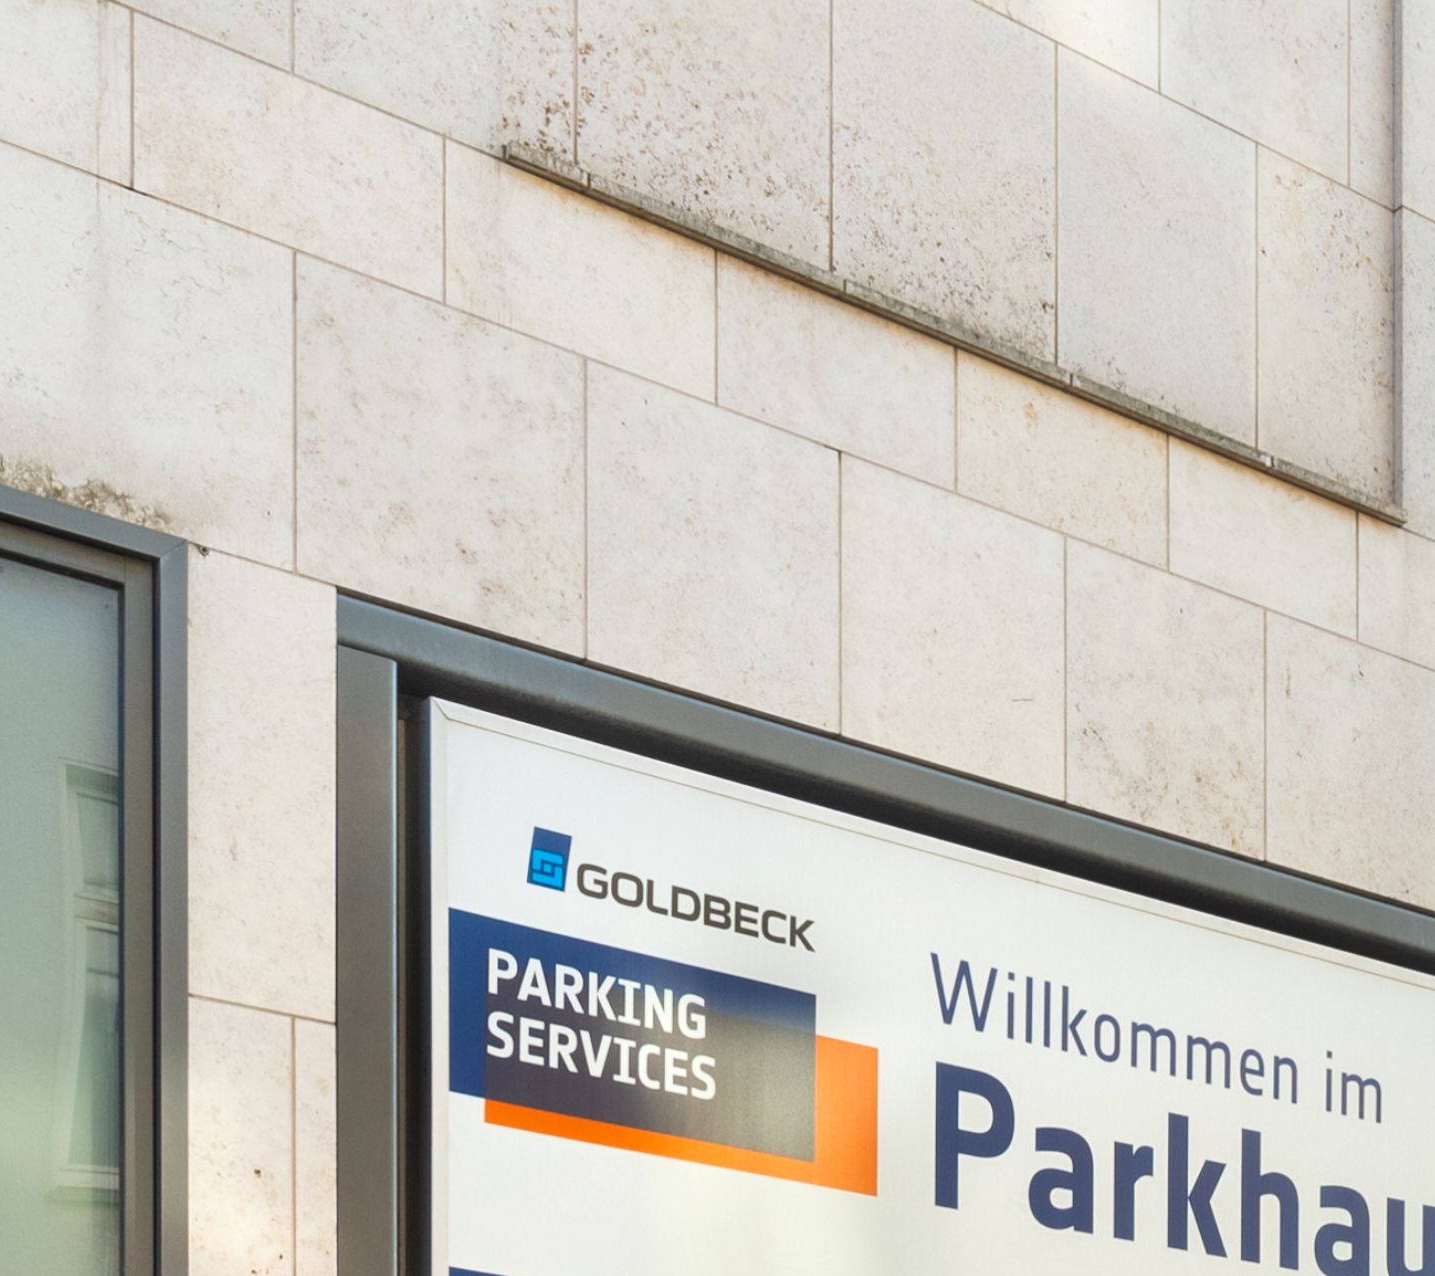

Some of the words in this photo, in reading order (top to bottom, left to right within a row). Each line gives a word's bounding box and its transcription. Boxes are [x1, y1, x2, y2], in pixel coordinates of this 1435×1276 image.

[576, 862, 817, 952] GOLDBECK
[486, 947, 708, 1040] PARKING
[930, 951, 1300, 1105] Willkommen
[1323, 1049, 1384, 1124] im
[485, 1011, 717, 1102] SERVICES
